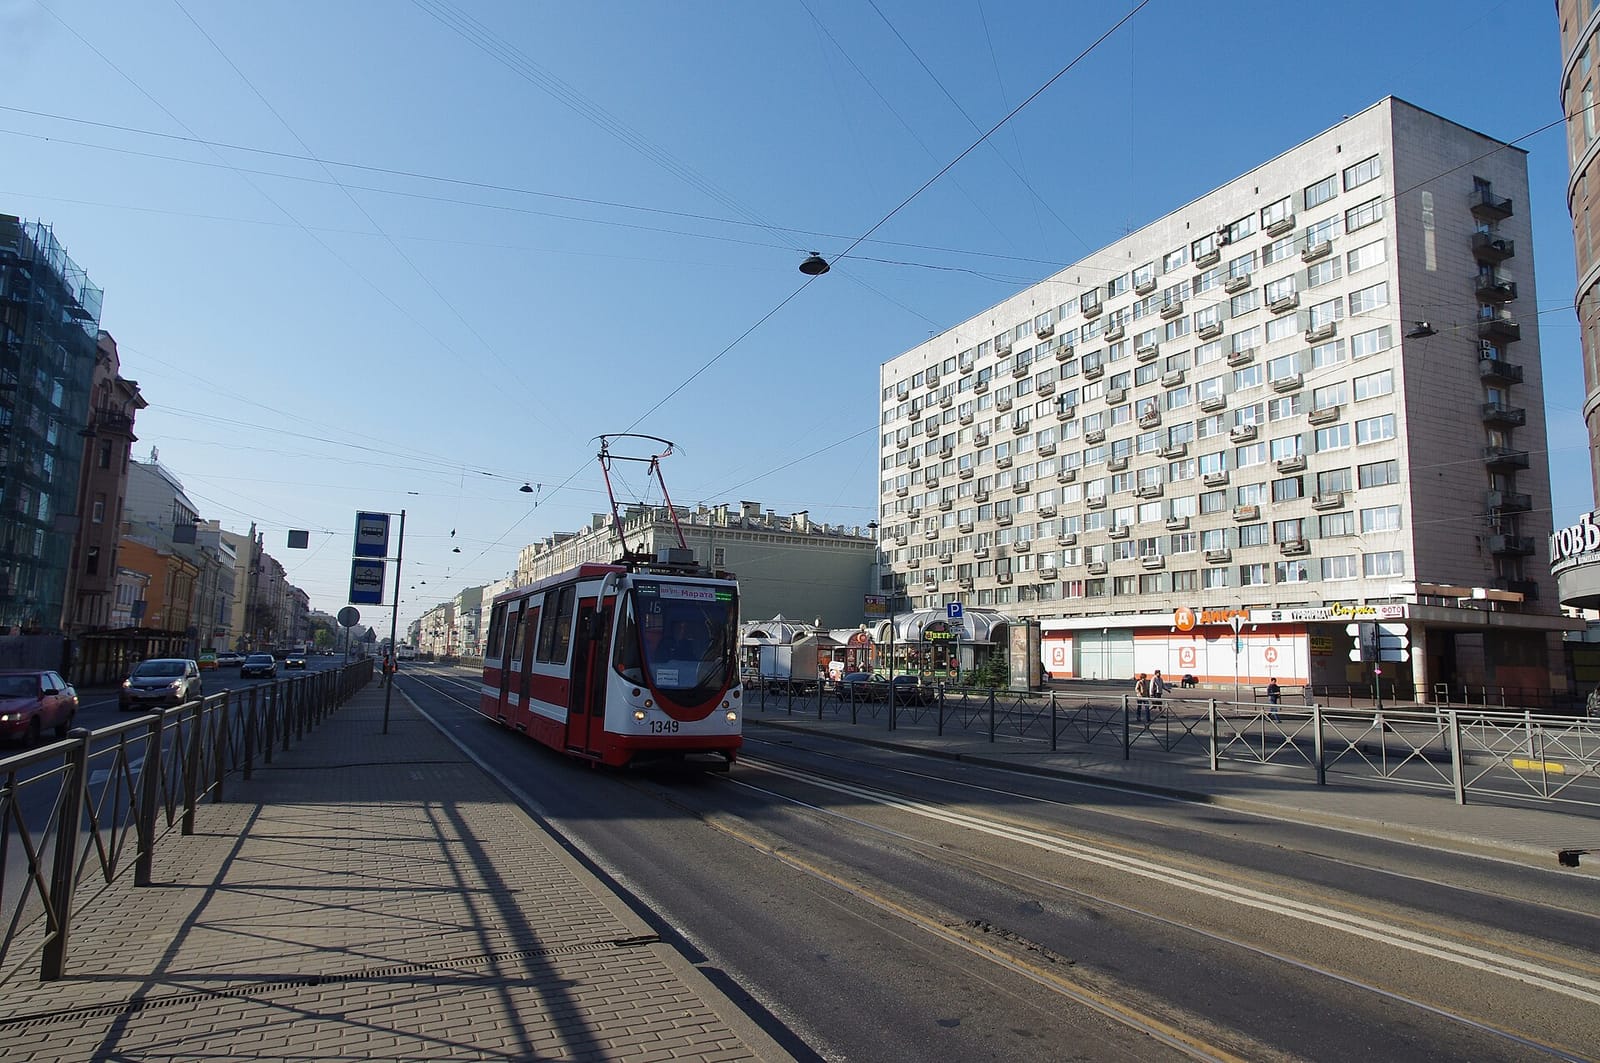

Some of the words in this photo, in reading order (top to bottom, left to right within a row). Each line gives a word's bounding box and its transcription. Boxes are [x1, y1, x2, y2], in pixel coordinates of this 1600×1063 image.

[681, 590, 713, 599] Марата
[950, 604, 960, 617] P
[1382, 606, 1401, 615] ФОТО
[649, 720, 679, 733] 1349
